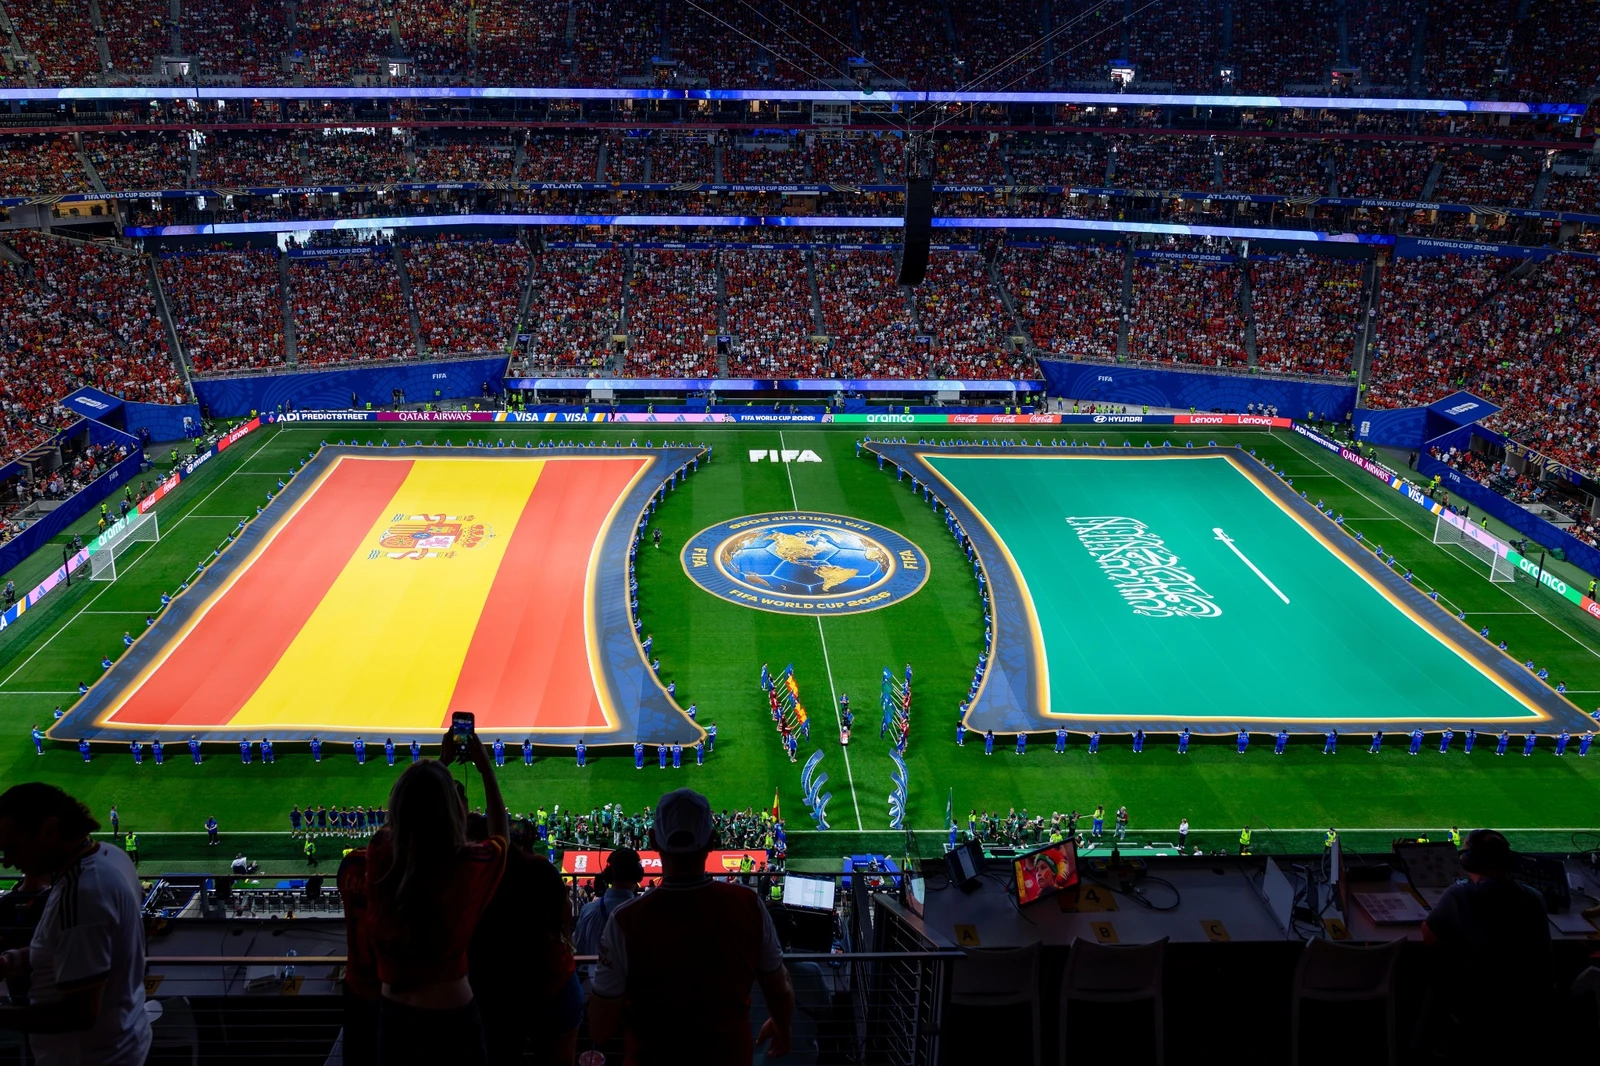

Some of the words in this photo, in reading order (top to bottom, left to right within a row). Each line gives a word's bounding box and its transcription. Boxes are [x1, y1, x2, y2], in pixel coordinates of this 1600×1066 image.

[276, 413, 300, 422] ADI
[399, 412, 431, 421] QATAR
[433, 412, 471, 420] AIRWAYS
[514, 413, 538, 421] VISA
[564, 413, 587, 421] VISA
[867, 414, 914, 423] aramco
[1238, 416, 1272, 425] Lenovo
[229, 427, 248, 443] Lenovo
[1295, 426, 1306, 436] ADI
[1306, 432, 1339, 452] PREDICTSTREET
[193, 450, 211, 469] HYUNDAI
[749, 449, 822, 462] FIFA
[1342, 449, 1363, 466] QATAR
[1364, 462, 1390, 482] AIRWAYS
[109, 471, 119, 481] FIFA
[1449, 472, 1460, 483] FIFA
[1408, 487, 1424, 505] VISA
[729, 518, 771, 529] 2026
[798, 515, 842, 524] WORLD
[845, 521, 870, 531] FIFA
[693, 547, 708, 568] FIFA
[899, 549, 918, 569] FIFA
[1520, 558, 1566, 594] aramco
[729, 589, 759, 602] FIFA
[761, 598, 813, 609] WORLD
[816, 601, 845, 609] CUP
[846, 591, 892, 607] 2026
[1099, 928, 1111, 938] B
[1210, 925, 1223, 935] C
[1332, 924, 1344, 935] A
[963, 930, 974, 941] A
[286, 980, 296, 990] A
